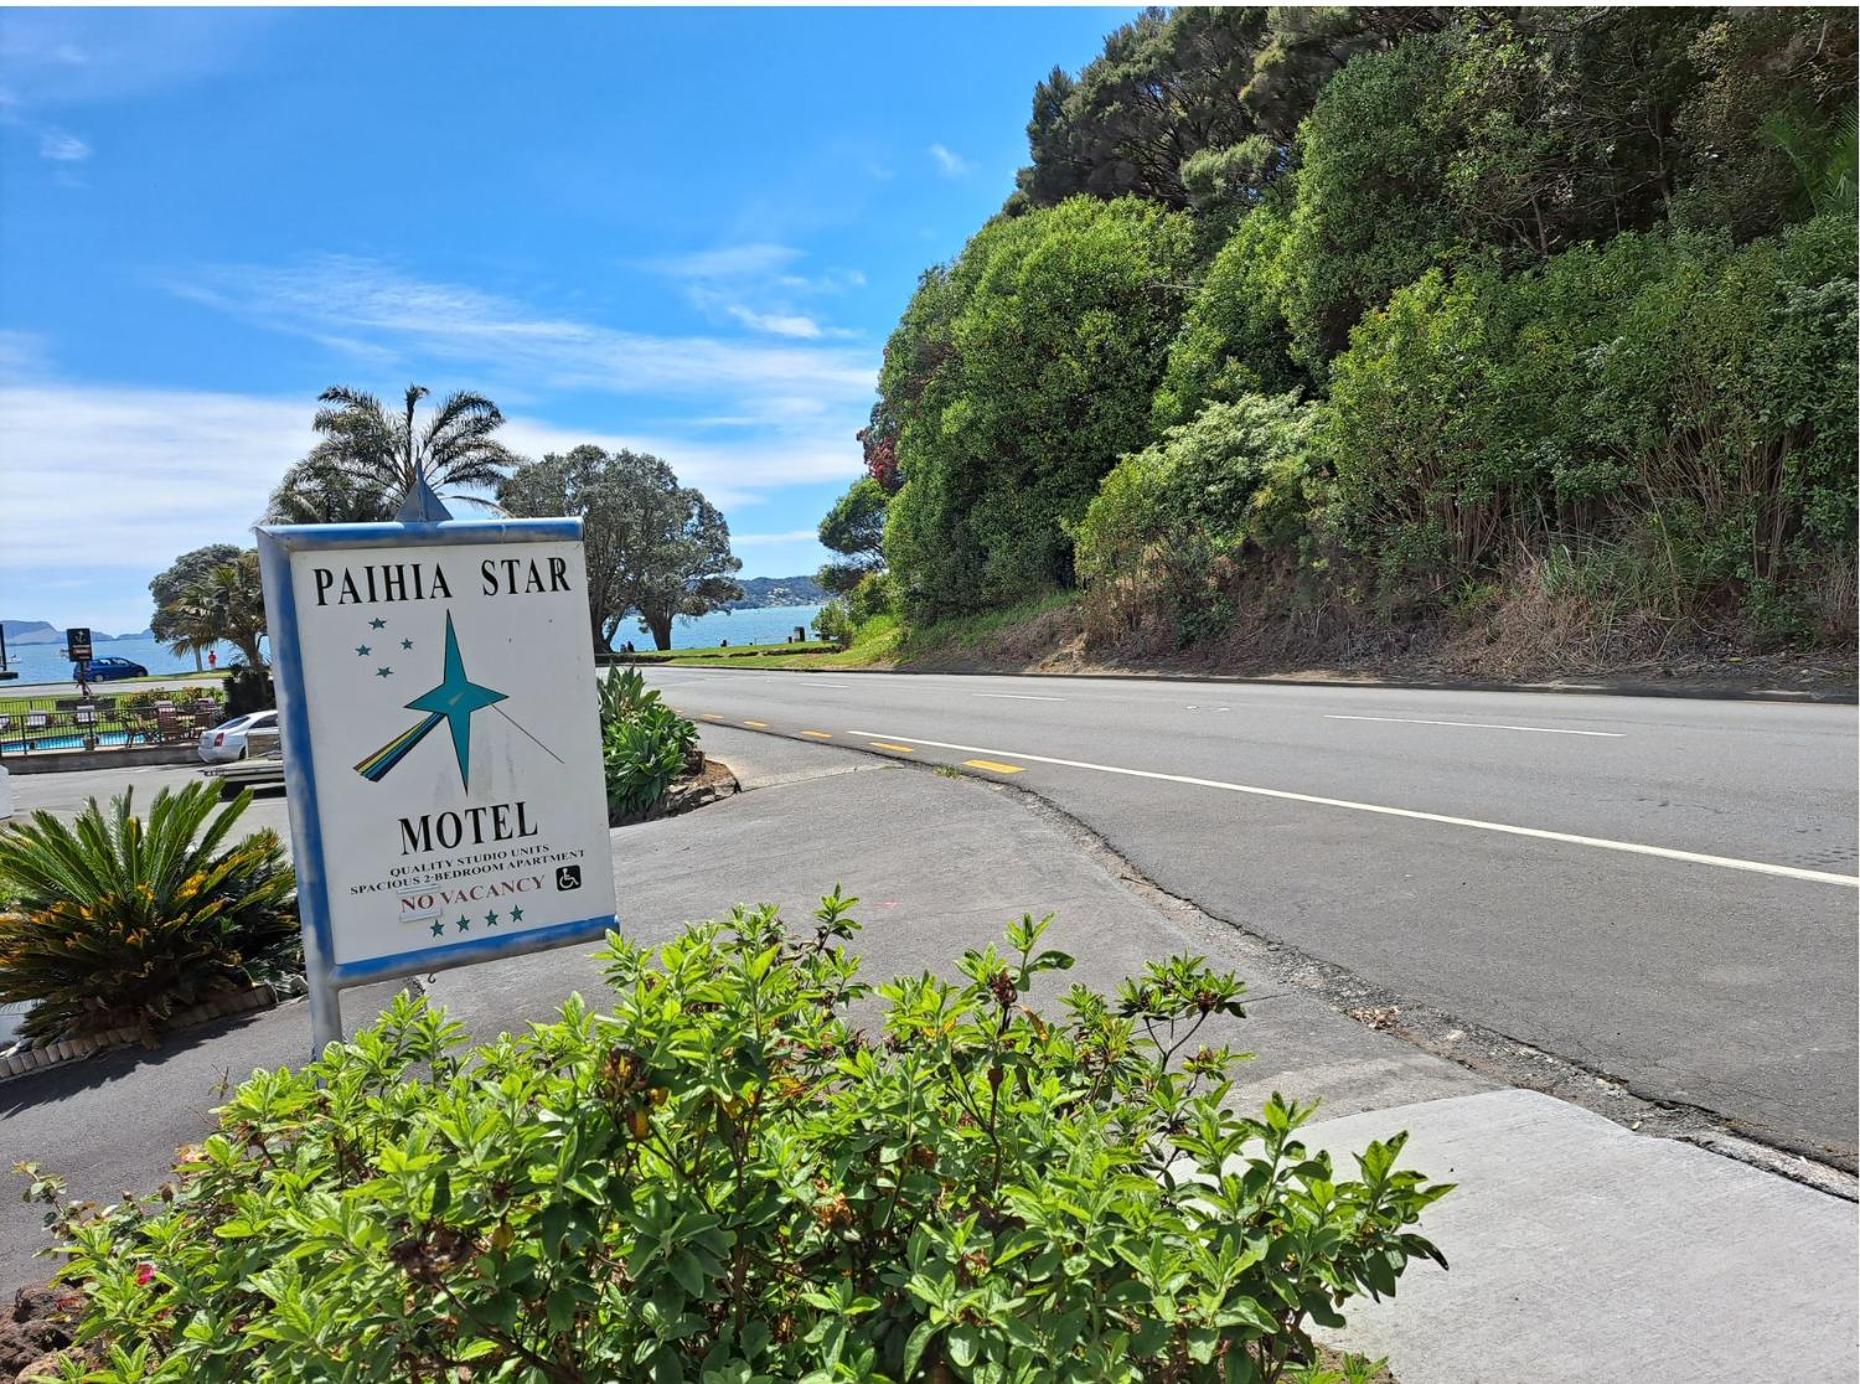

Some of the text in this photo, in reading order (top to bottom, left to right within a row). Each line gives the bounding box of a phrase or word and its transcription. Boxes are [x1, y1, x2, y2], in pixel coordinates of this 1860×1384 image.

[313, 557, 572, 606] PAIHIA STAR
[398, 801, 538, 855] MOTEL
[350, 849, 585, 895] SPACIOUS 2-BEDROOM APARTMENT
[390, 844, 550, 877] QUALITY STUDIO UNITS
[400, 874, 545, 913] NO VACANCY
